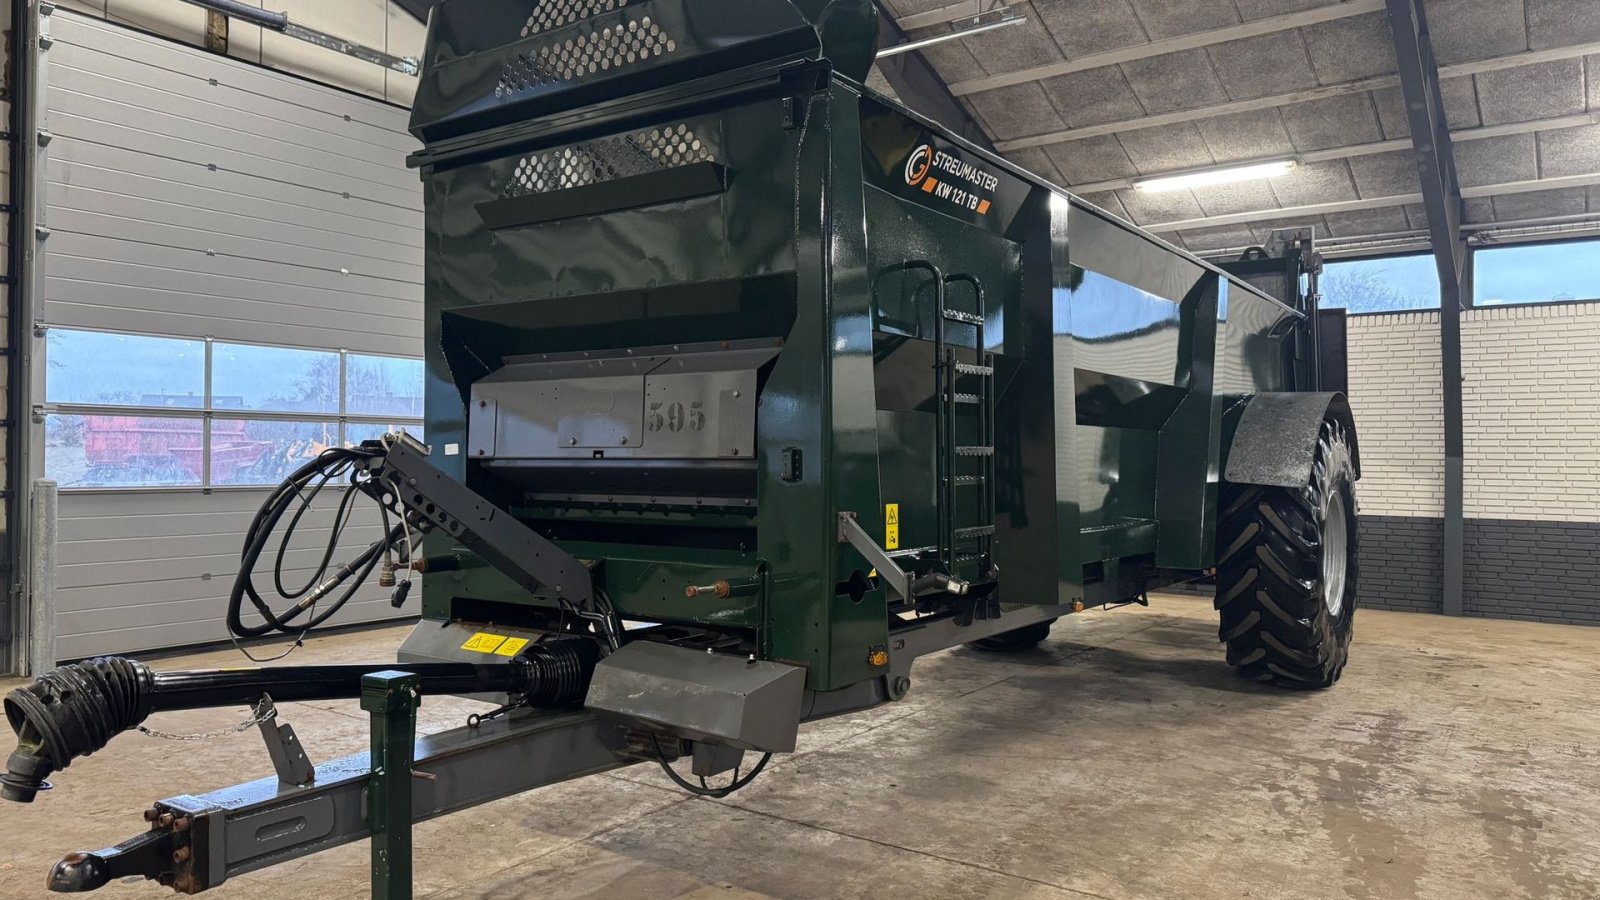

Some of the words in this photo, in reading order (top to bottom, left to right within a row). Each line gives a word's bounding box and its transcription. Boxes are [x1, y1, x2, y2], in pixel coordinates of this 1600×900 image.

[932, 151, 998, 192] STREUMASTER
[935, 181, 953, 199] KW
[951, 188, 967, 206] 121
[966, 194, 978, 210] TB
[648, 401, 706, 433] 595
